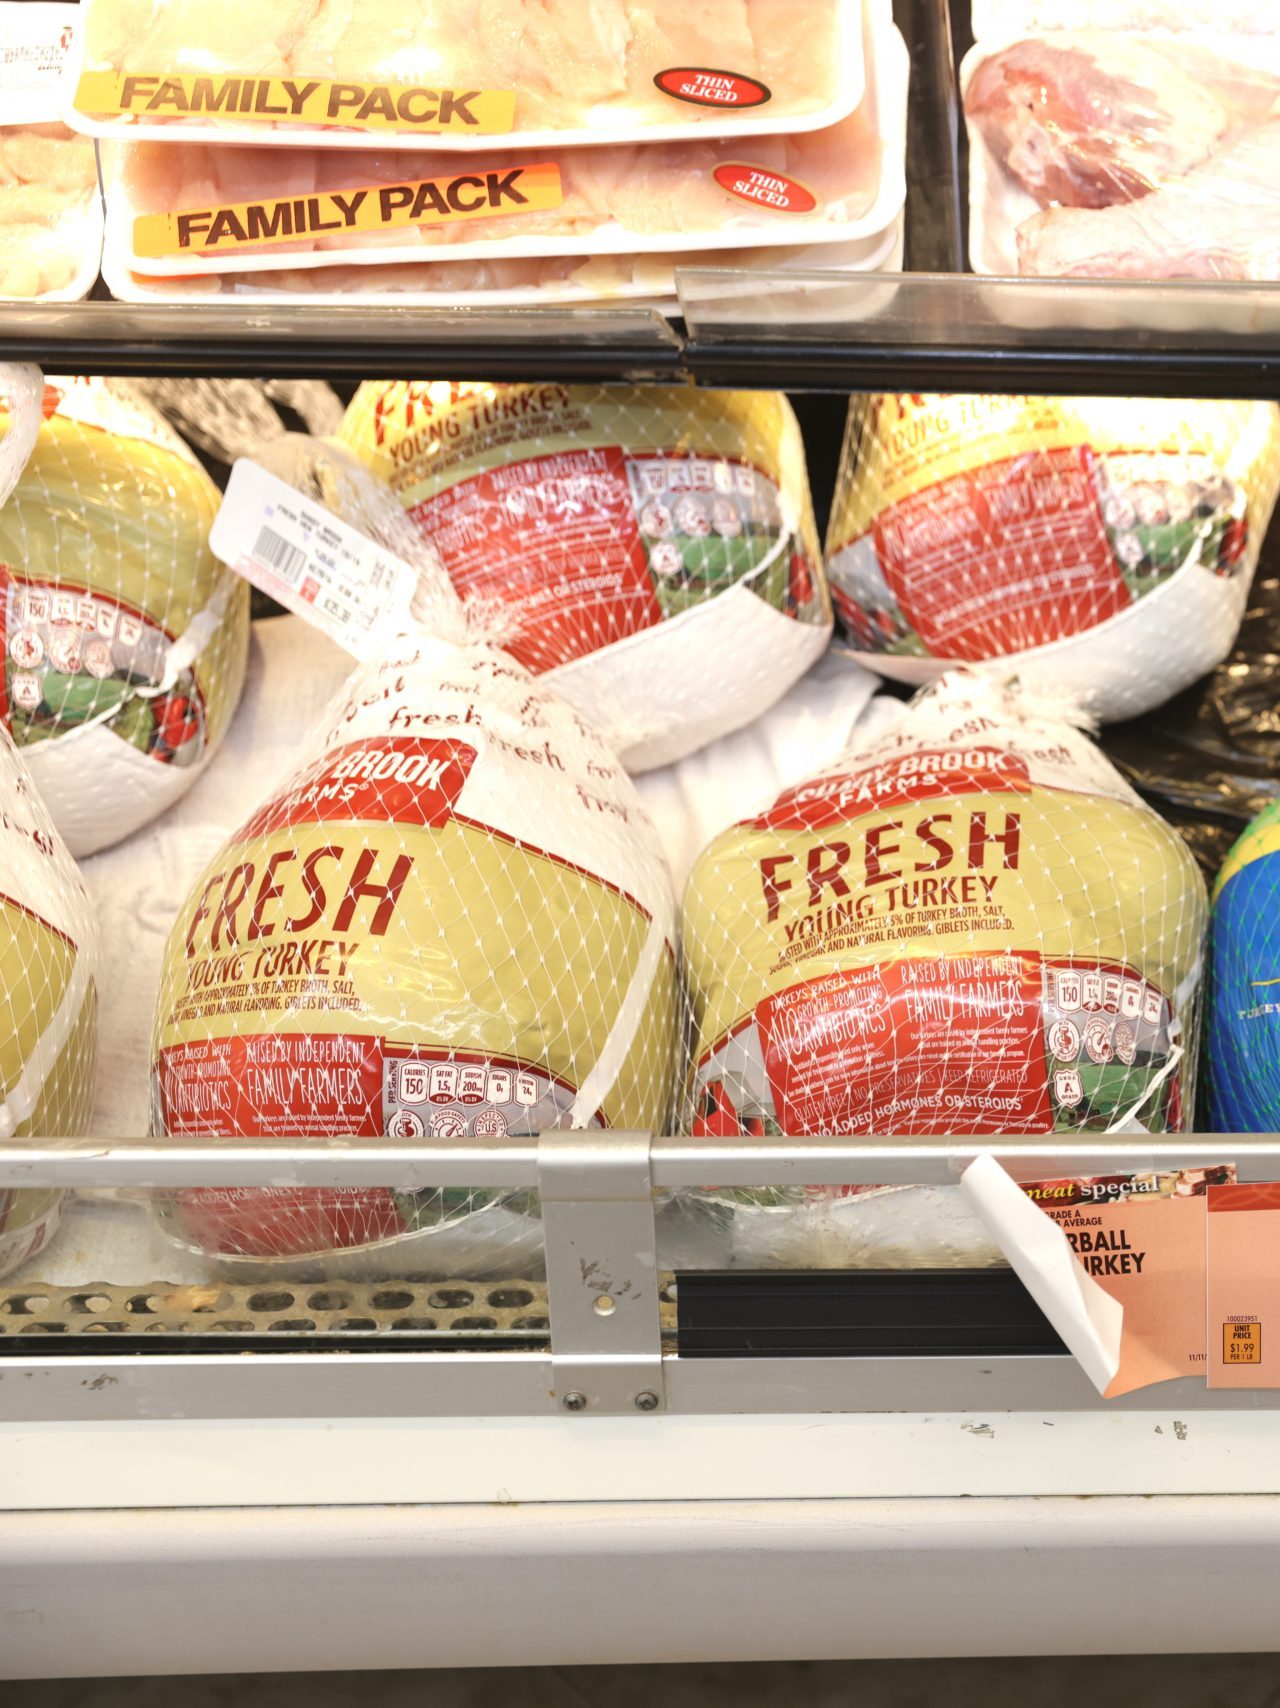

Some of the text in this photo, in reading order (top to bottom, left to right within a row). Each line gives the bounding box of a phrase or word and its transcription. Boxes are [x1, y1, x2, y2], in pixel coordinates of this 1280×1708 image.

[680, 83, 738, 102] SLICED
[695, 74, 735, 89] THIN
[120, 76, 484, 124] FAMILY PACK
[733, 180, 789, 208] SLICED
[750, 172, 788, 193] THIN
[178, 169, 529, 247] FAMILY PACK
[390, 414, 462, 468] YOUNG
[469, 385, 572, 430] TURKEY
[389, 703, 483, 735] fresh
[331, 750, 452, 791] BROOK
[899, 749, 1009, 774] BROOK
[839, 770, 939, 808] FARMS
[760, 811, 1020, 924] FRESH
[185, 845, 415, 959] FRESH
[784, 876, 998, 943] YOUNG TURKEY
[822, 905, 1006, 943] APPROXIMATELY TURKEY BROTH, SALT,
[827, 940, 845, 953] AND
[847, 932, 886, 949] NATURAL
[935, 922, 969, 935] GIBLETS
[186, 938, 361, 993] YOUNG TURKEY
[900, 955, 1024, 985] RAISED BY INDEPENDENT
[332, 981, 355, 996] SALT,
[811, 977, 848, 995] RAISED
[1062, 987, 1078, 1003] 150
[904, 984, 955, 1023] FAMILY
[959, 981, 1025, 1020] FARMERS
[770, 1008, 803, 1064] NO
[803, 1002, 887, 1053] ANTIBIOTICS
[211, 1043, 231, 1057] WITH
[280, 1040, 292, 1064] BY
[294, 1040, 366, 1065] INDEPENDENT
[404, 1068, 426, 1076] CALORIES
[246, 1067, 297, 1106] FAMILY
[300, 1068, 364, 1106] FARMERS
[405, 1078, 424, 1095] 150
[853, 1086, 868, 1099] NO
[835, 1111, 873, 1134] ADDED
[875, 1096, 943, 1119] HORMONES
[1026, 1175, 1160, 1200] meat special
[1063, 1217, 1103, 1227] AVERAGE
[1075, 1209, 1081, 1218] A
[1065, 1229, 1132, 1254] RBALL
[1083, 1252, 1146, 1277] RKEY
[1226, 1315, 1258, 1323] 100023951
[1234, 1325, 1251, 1333] UNIT
[1230, 1343, 1255, 1353] $1.99
[1232, 1332, 1252, 1340] PRICE
